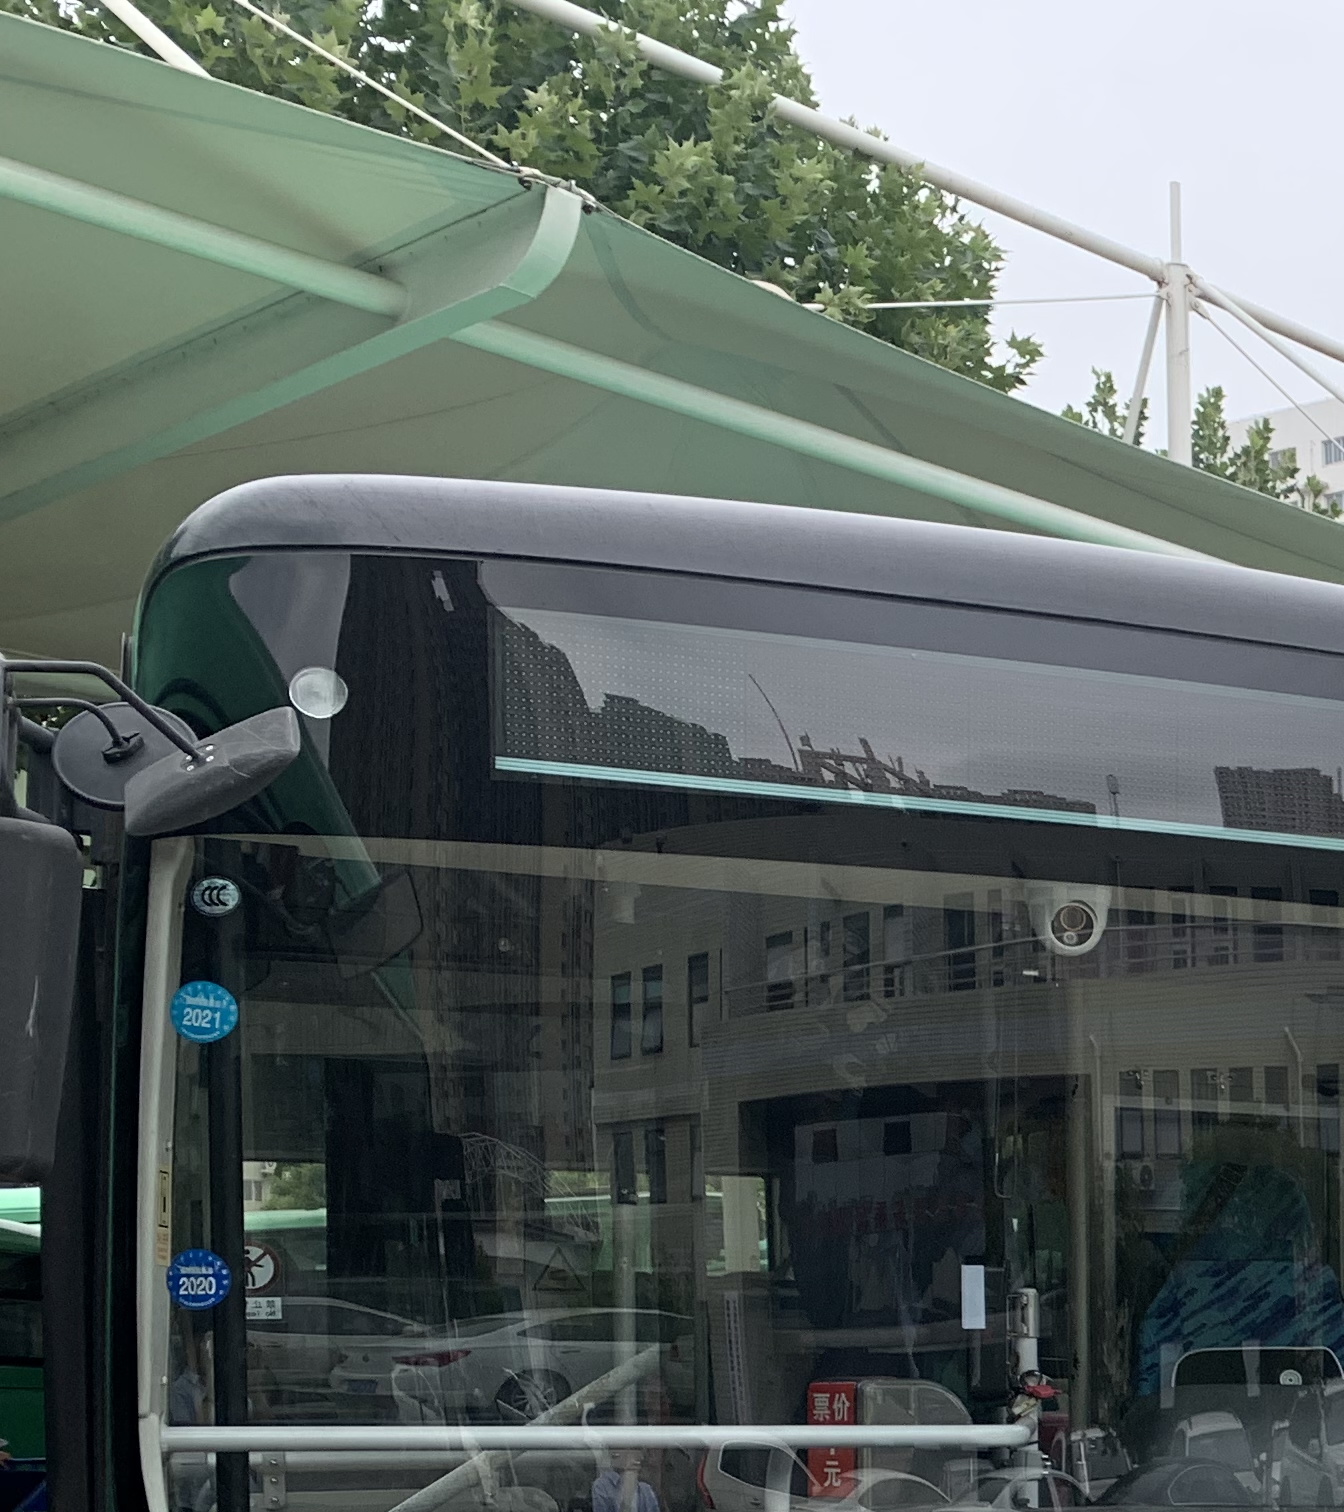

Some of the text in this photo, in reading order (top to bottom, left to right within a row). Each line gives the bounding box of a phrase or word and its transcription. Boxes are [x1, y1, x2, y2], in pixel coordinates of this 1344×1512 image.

[182, 1007, 221, 1029] 2021
[178, 1276, 217, 1295] 2020
[813, 1392, 851, 1421] 票价
[823, 1460, 841, 1487] 元
